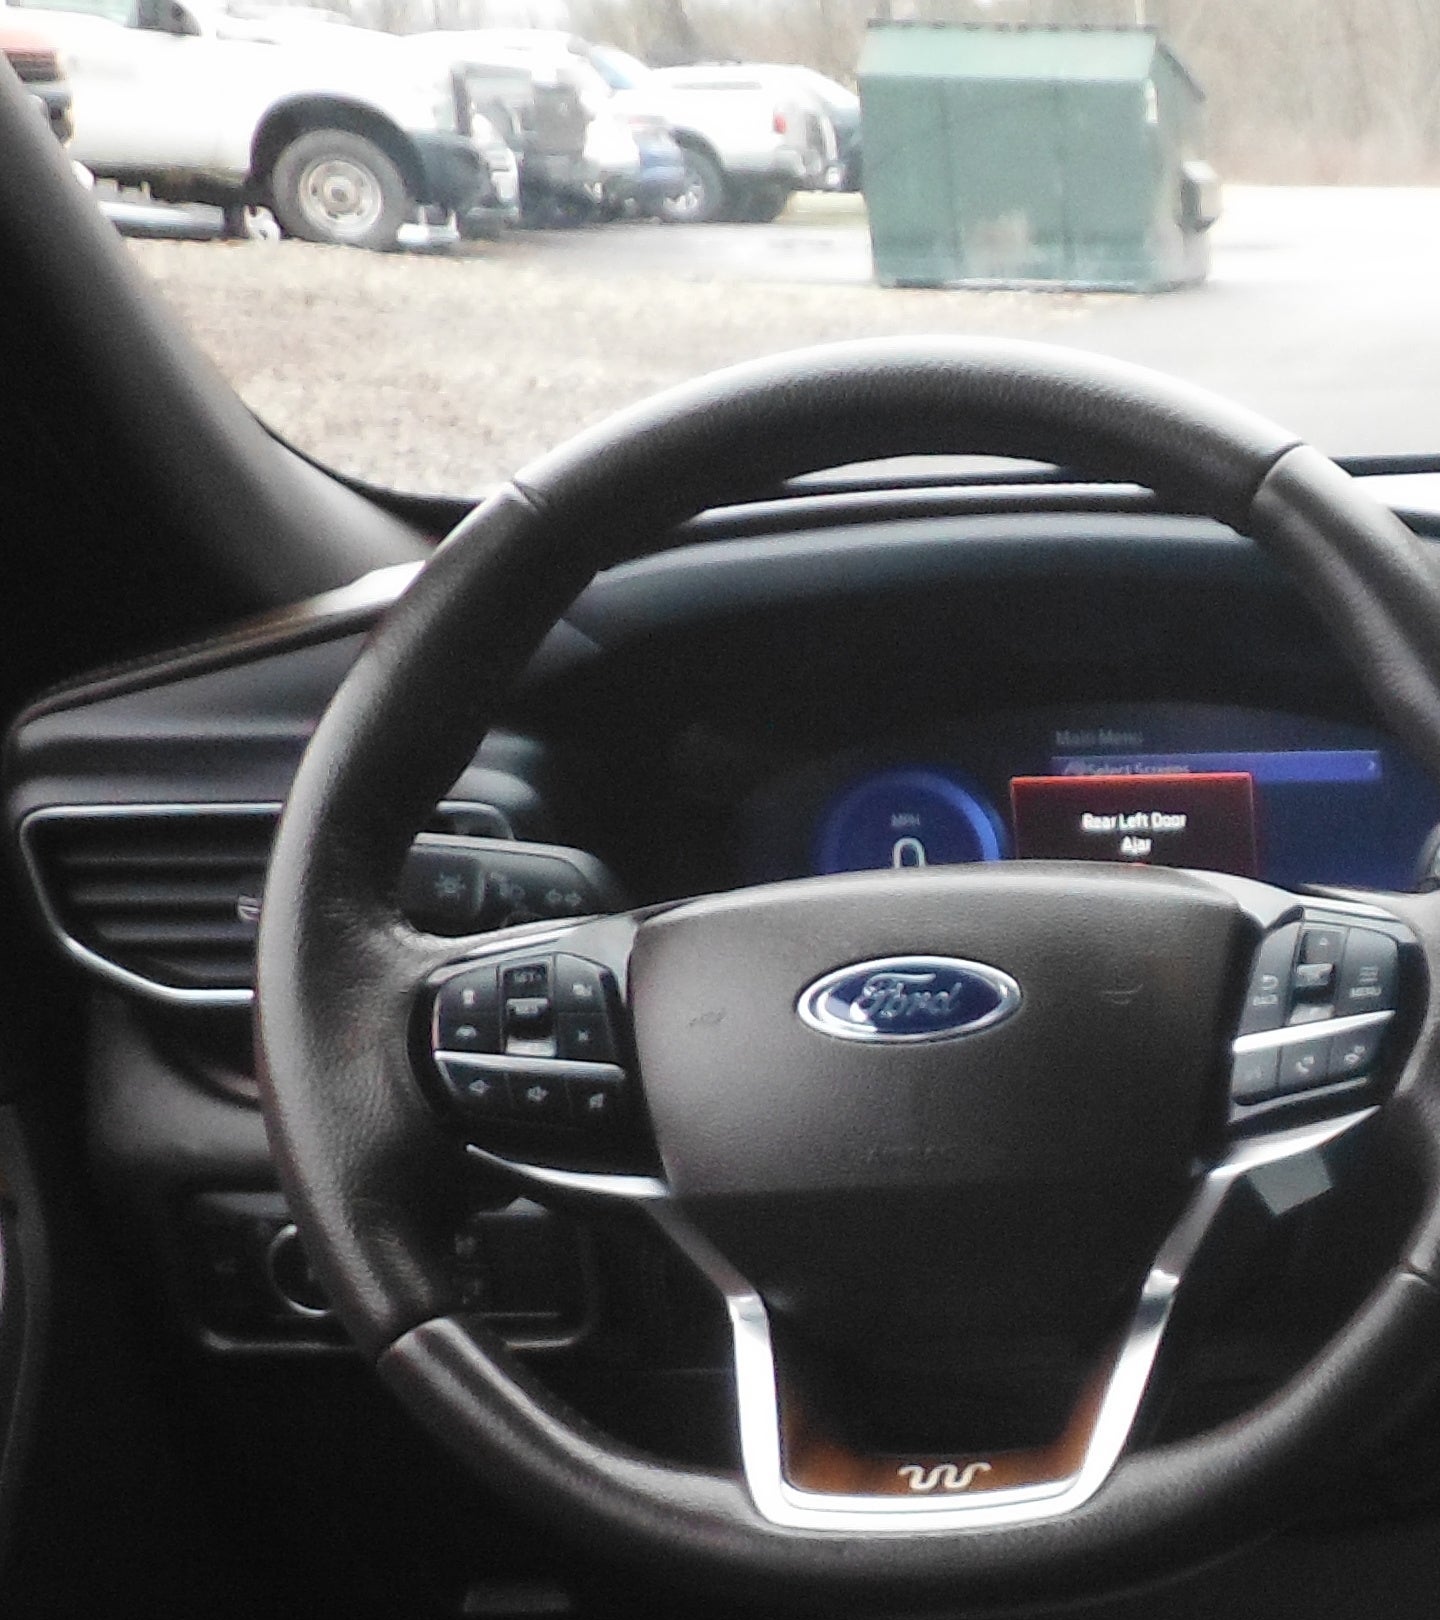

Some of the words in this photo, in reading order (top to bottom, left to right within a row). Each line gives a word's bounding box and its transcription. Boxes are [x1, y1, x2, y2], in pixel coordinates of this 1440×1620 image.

[1081, 813, 1116, 830] Rear
[1119, 812, 1149, 830] Left
[1152, 811, 1186, 829] Door
[1120, 838, 1151, 855] Ajar
[861, 972, 962, 1020] Ford
